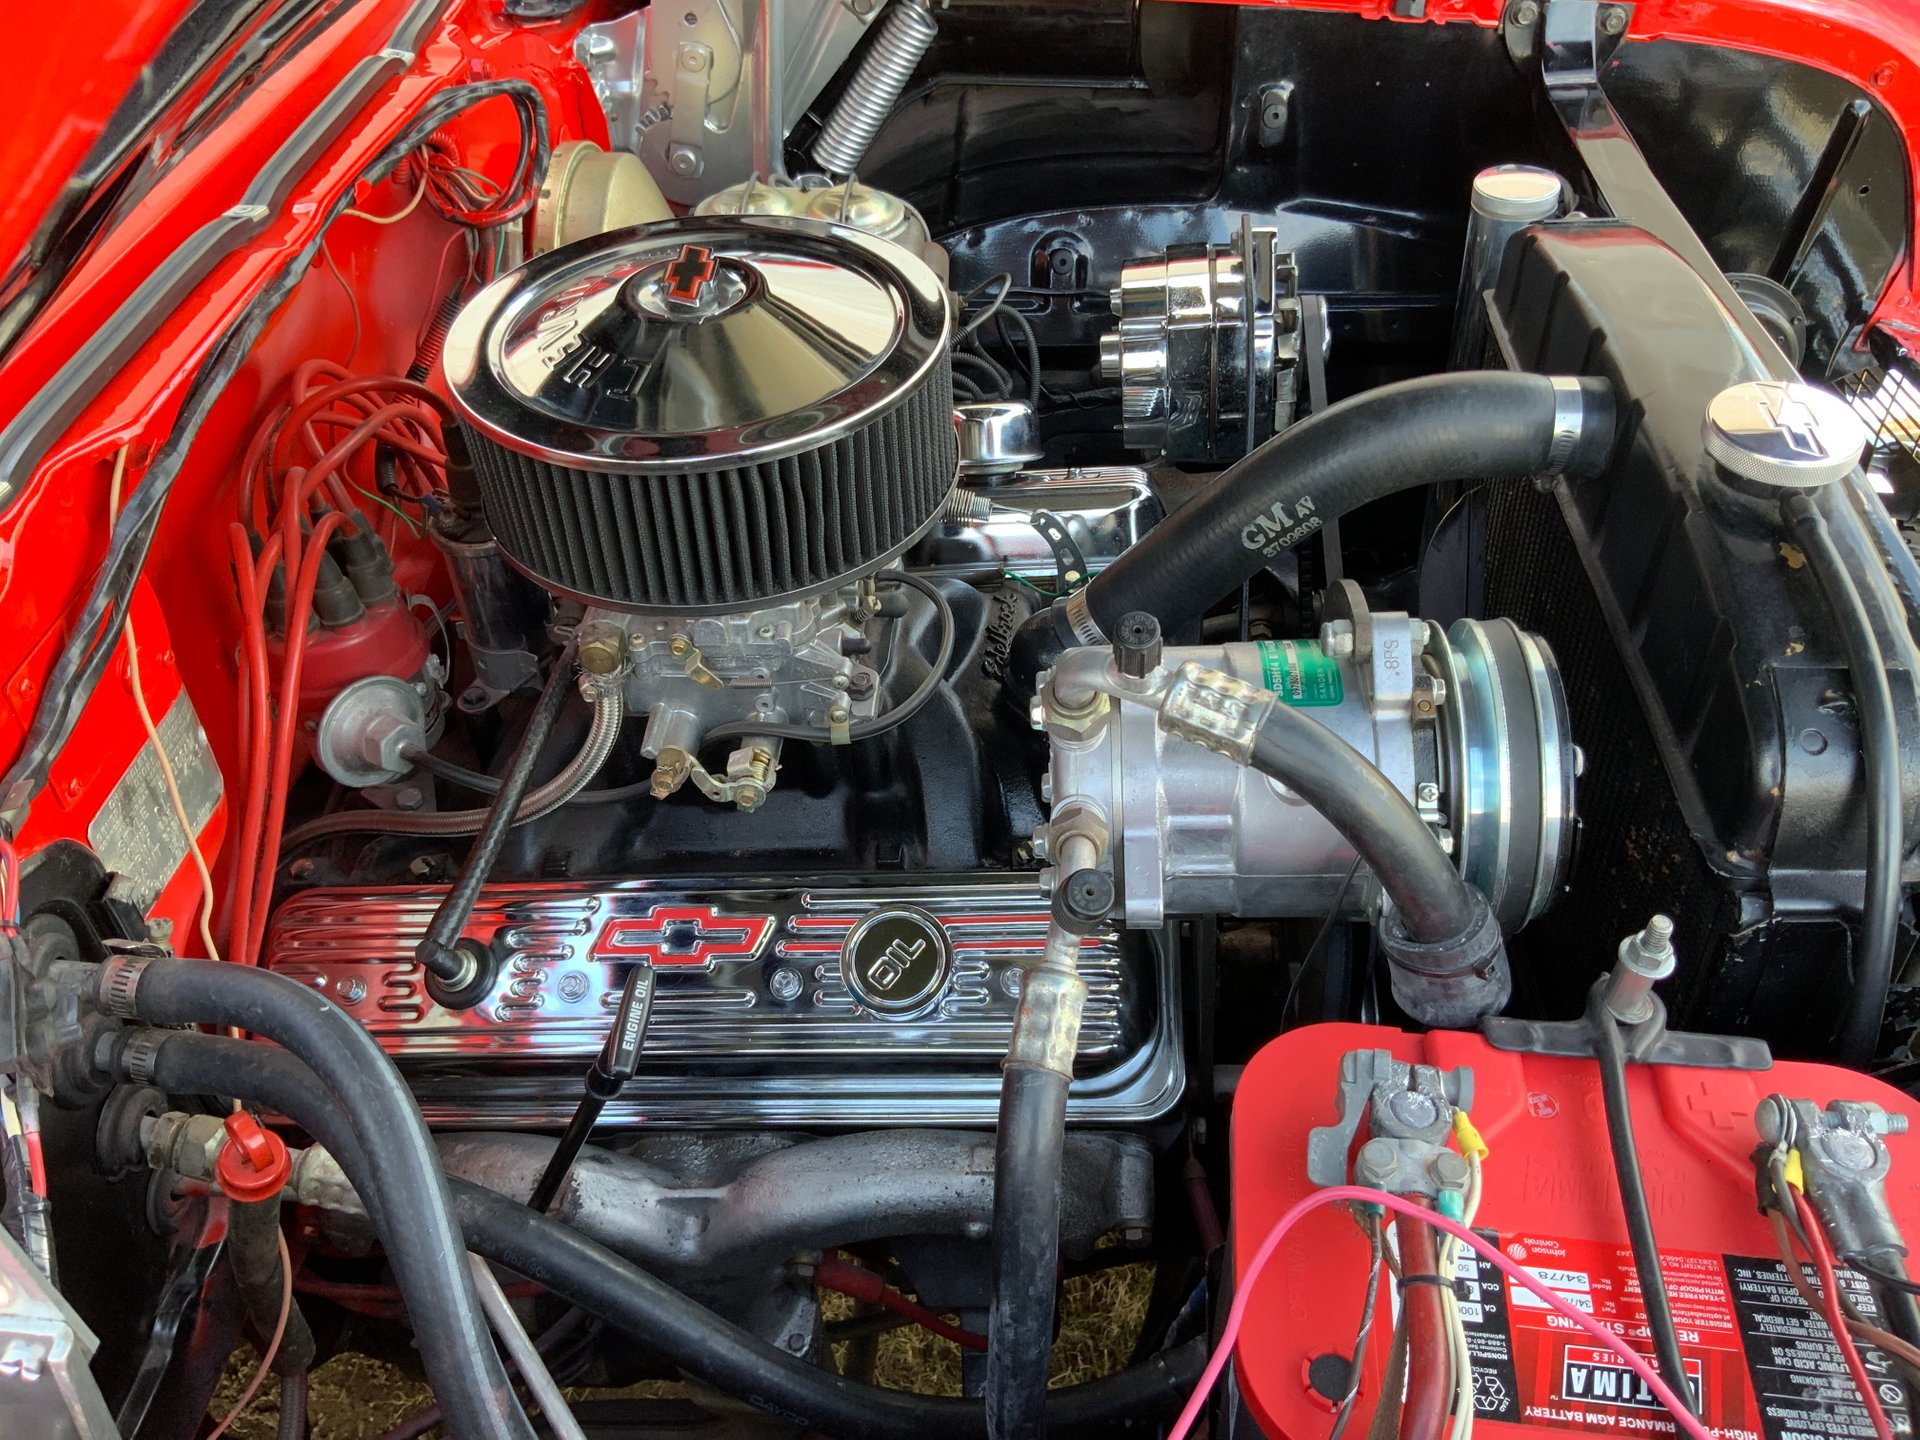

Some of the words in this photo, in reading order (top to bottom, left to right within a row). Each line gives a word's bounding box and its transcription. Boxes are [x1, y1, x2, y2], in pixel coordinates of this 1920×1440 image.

[1241, 501, 1294, 550] GM
[983, 593, 1017, 677] Edelbrock
[1317, 668, 1327, 699] SANDEN
[867, 937, 926, 991] OIL
[621, 1000, 644, 1052] ENGINE
[633, 978, 649, 998] OIL
[1522, 1238, 1559, 1249] Controls
[1531, 1246, 1566, 1257] Johnson
[1479, 1261, 1491, 1269] AH
[1538, 1271, 1587, 1284] 34/78
[1481, 1282, 1500, 1291] CCA
[1592, 1283, 1612, 1291] Model
[1680, 1285, 1704, 1294] PROOF
[1706, 1287, 1725, 1295] WITH
[1739, 1282, 1777, 1293] BATTERY!
[1777, 1285, 1800, 1296] OPEN
[1679, 1292, 1698, 1300] FREE
[1484, 1304, 1497, 1313] CA
[1601, 1306, 1616, 1314] Part
[1855, 1303, 1877, 1312] KEEP
[1672, 1316, 1694, 1325] YOUR
[1695, 1319, 1733, 1329] REGISTER
[1752, 1313, 1785, 1325] MEDICAL
[1786, 1317, 1800, 1327] GET
[1760, 1323, 1809, 1337] IMMEDIATELY
[1808, 1328, 1827, 1339] EYES
[1771, 1347, 1784, 1356] OR
[1795, 1340, 1824, 1352] BURNS
[1467, 1350, 1508, 1361] NONSPILL
[1785, 1347, 1831, 1361] BLINDNESS
[1774, 1356, 1792, 1366] CAN
[1793, 1358, 1815, 1370] ACID
[1816, 1360, 1850, 1373] LFURIC
[1471, 1366, 1498, 1375] RECYCL
[1789, 1374, 1830, 1388] SMOKING
[1499, 1397, 1511, 1413] LEAD
[1524, 1405, 1584, 1423] BATTERY
[1766, 1407, 1808, 1421] BLINDNESS
[1586, 1412, 1616, 1428] AGM
[1826, 1423, 1849, 1435] EYES
